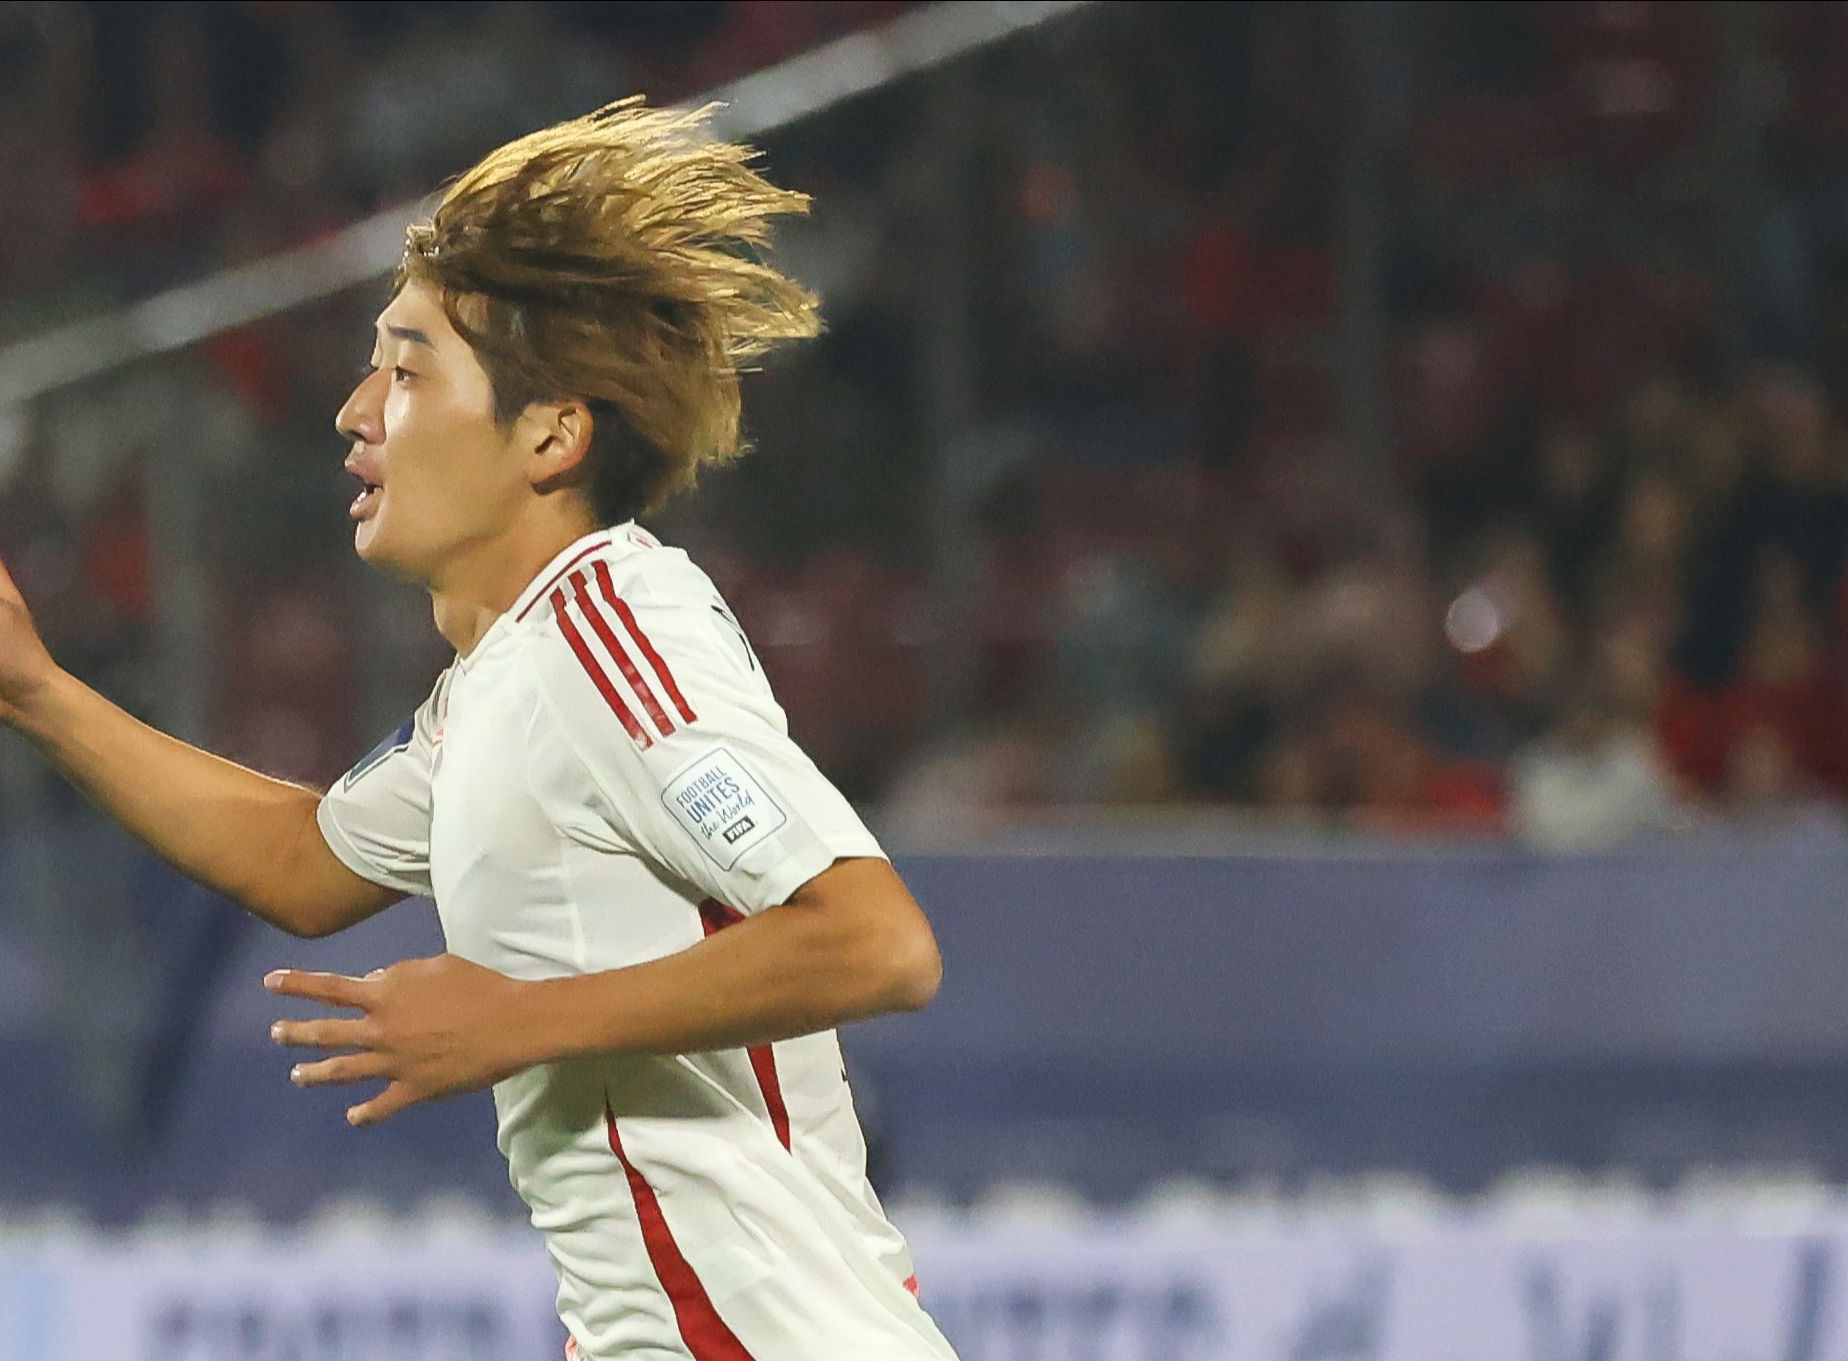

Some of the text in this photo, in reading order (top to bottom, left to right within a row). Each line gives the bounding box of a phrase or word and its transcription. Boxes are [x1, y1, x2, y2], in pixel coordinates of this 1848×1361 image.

[677, 766, 727, 808] FOOTBALL
[686, 776, 740, 824] UNITES
[700, 789, 756, 841] the World
[724, 817, 754, 842] FIFA
